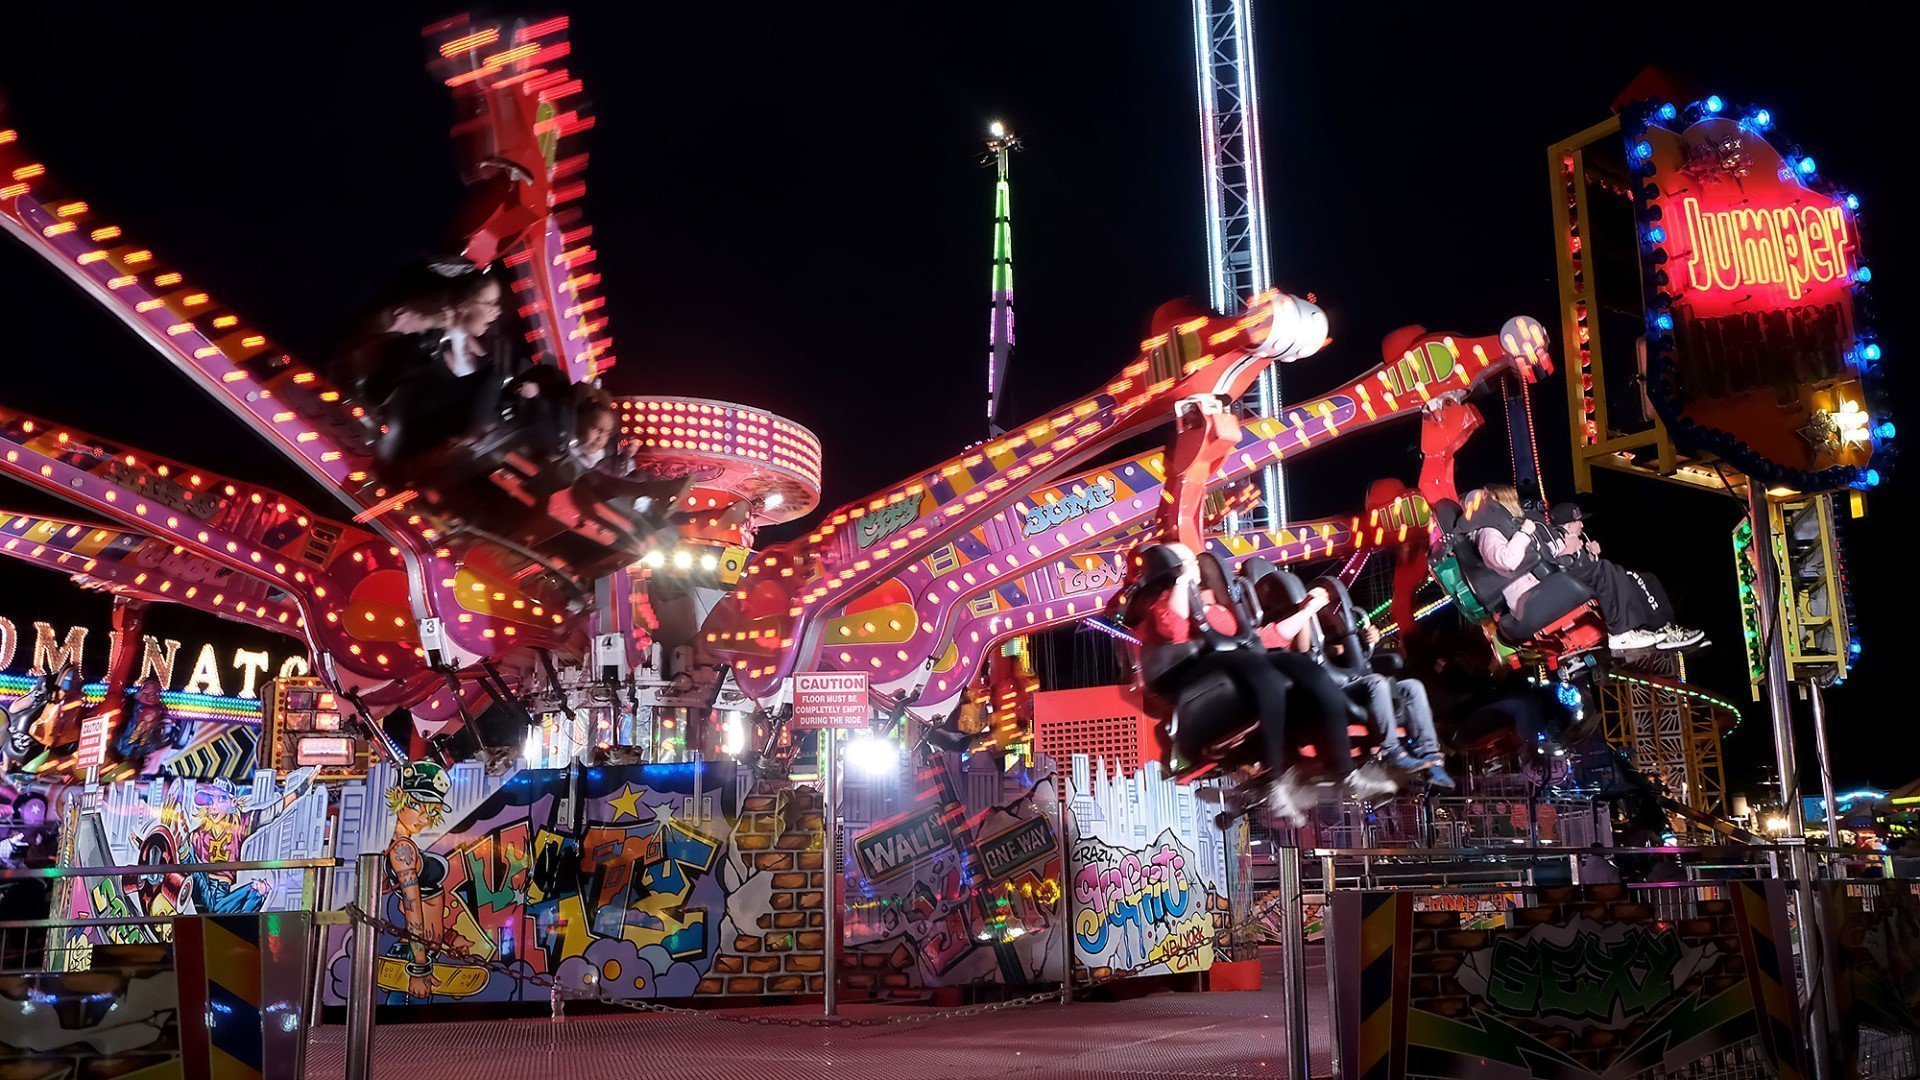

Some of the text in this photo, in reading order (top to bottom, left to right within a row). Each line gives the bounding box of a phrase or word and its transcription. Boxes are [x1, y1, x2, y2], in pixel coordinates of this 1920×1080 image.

[1683, 197, 1848, 300] Jumper
[1057, 563, 1127, 594] LOV
[426, 620, 435, 633] 3
[800, 678, 864, 690] CAUTION
[802, 695, 858, 703] FLOOR MUST BE
[795, 705, 866, 714] COMPLETELY EMPTY
[800, 716, 862, 724] DURING THE RIDE
[864, 821, 945, 873] WALL
[984, 825, 1047, 870] ONE WAY
[1162, 924, 1205, 956] NEW YORK
[1487, 926, 1683, 1022] SEXY
